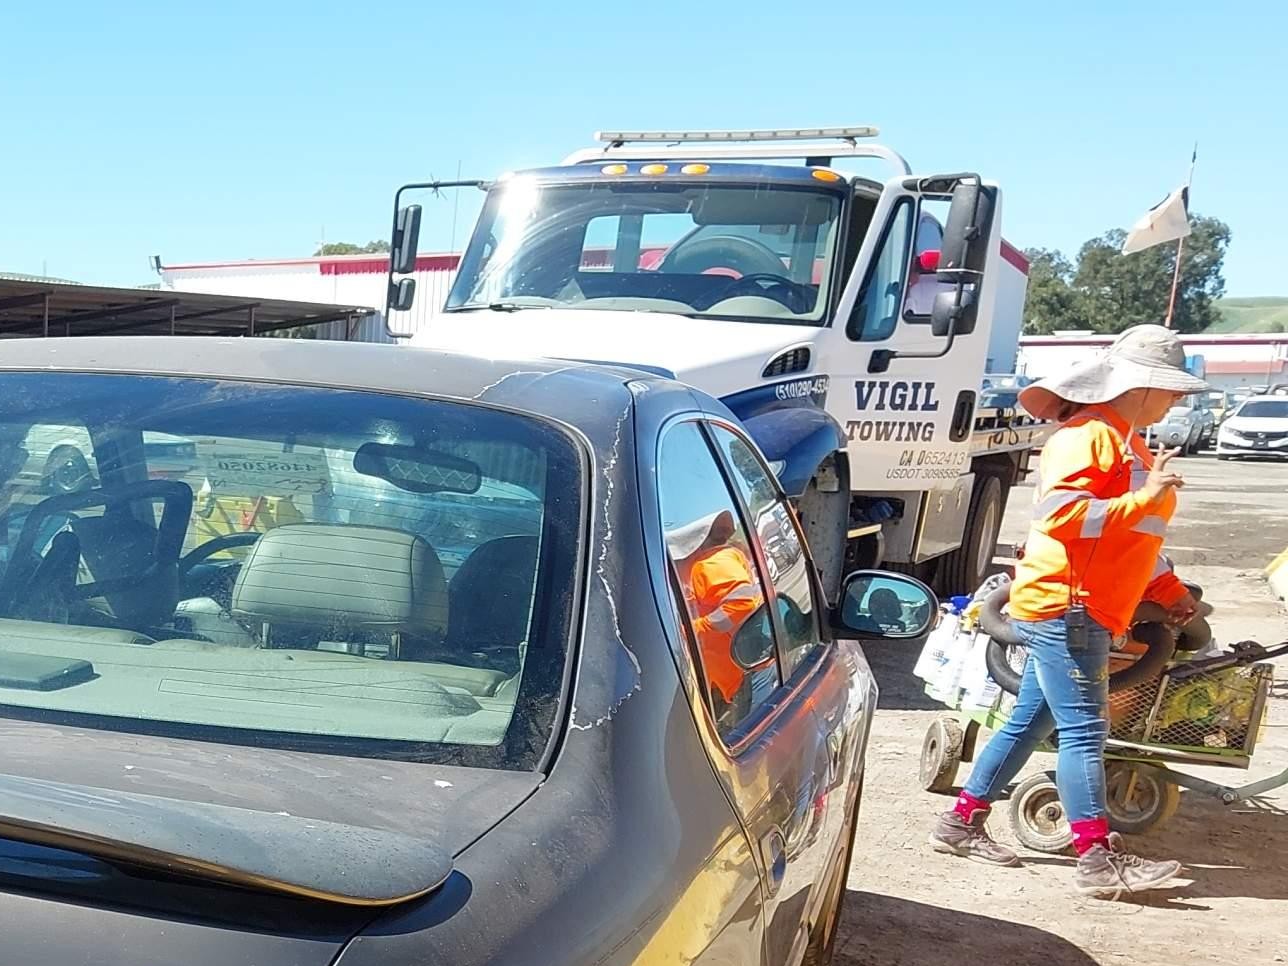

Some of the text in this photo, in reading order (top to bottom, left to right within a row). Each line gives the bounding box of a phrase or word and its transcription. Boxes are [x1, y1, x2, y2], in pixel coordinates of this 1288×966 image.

[854, 380, 940, 412] VIGIL
[845, 420, 936, 442] TOWING
[898, 450, 914, 467] CA
[885, 468, 922, 480] USDOT
